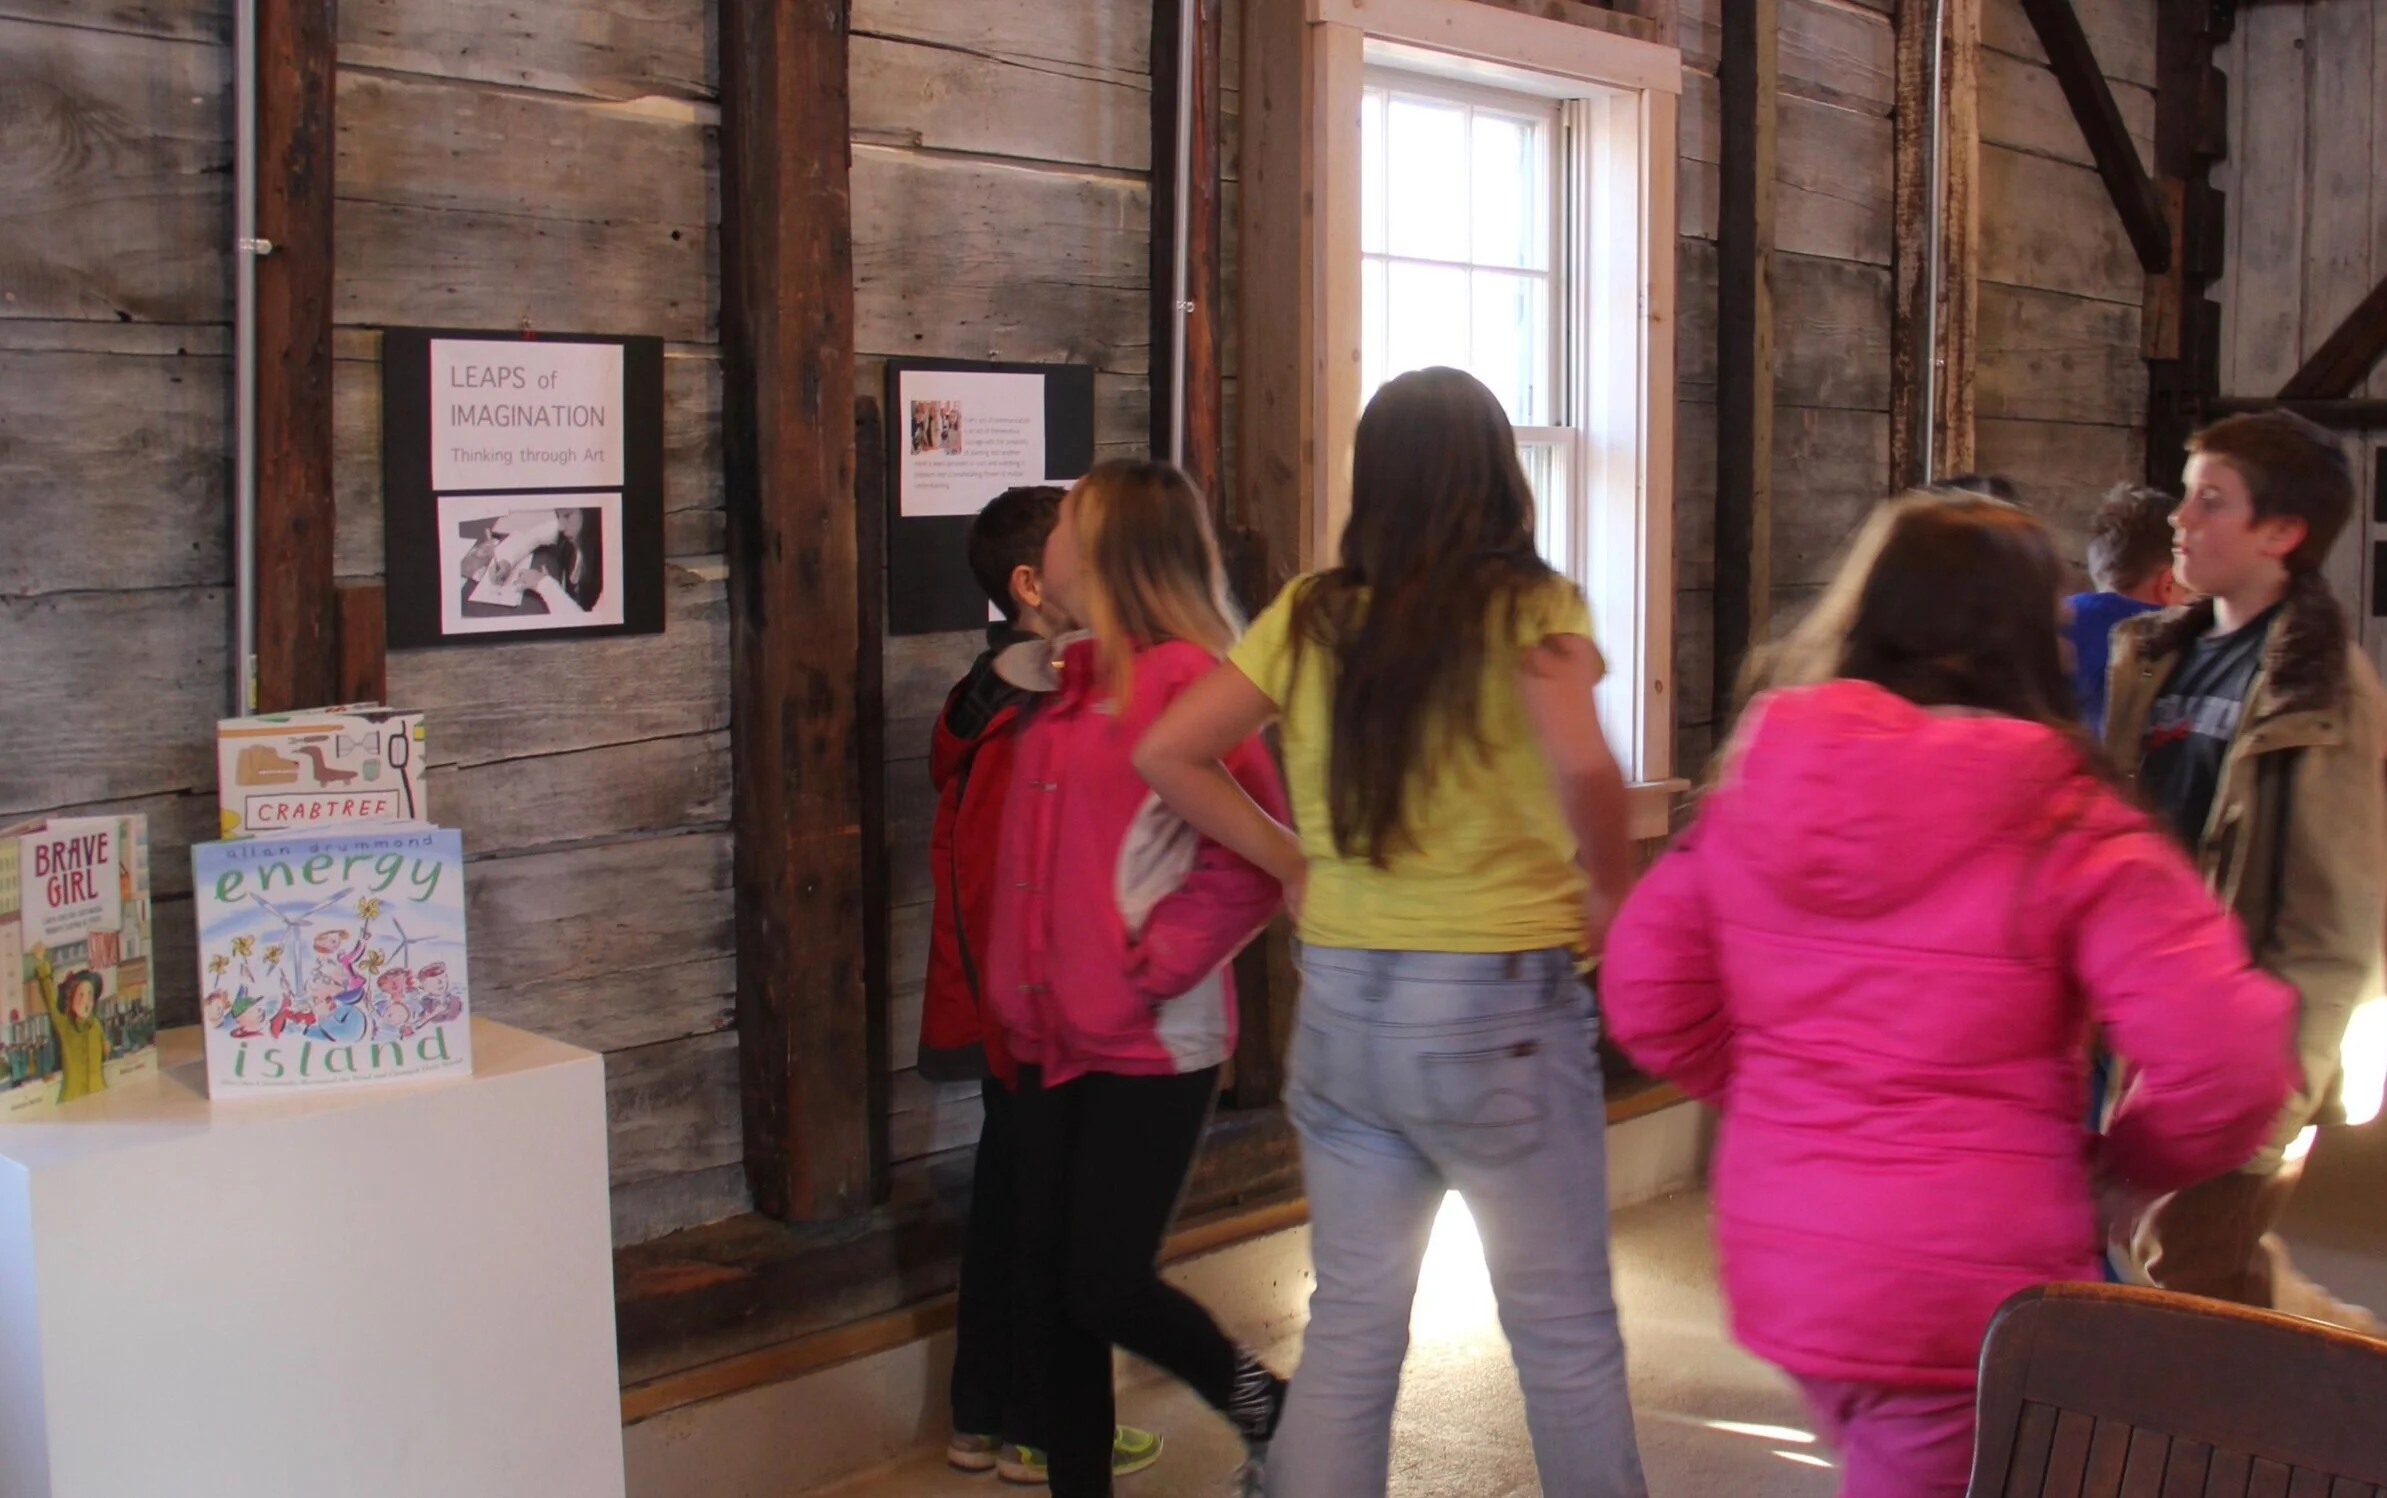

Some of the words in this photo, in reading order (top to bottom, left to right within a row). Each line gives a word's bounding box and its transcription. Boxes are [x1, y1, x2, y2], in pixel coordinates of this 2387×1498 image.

[450, 365, 526, 389] LEAPS
[537, 370, 559, 389] of
[450, 403, 605, 428] IMAGINATION
[451, 448, 513, 465] Thinking
[520, 448, 577, 465] through
[583, 448, 605, 462] Art
[34, 832, 108, 878] BRAVE
[226, 846, 290, 860] allan
[308, 834, 434, 854] drummond
[47, 868, 98, 908] GIRL
[214, 852, 443, 903] energy
[234, 1026, 450, 1079] island
